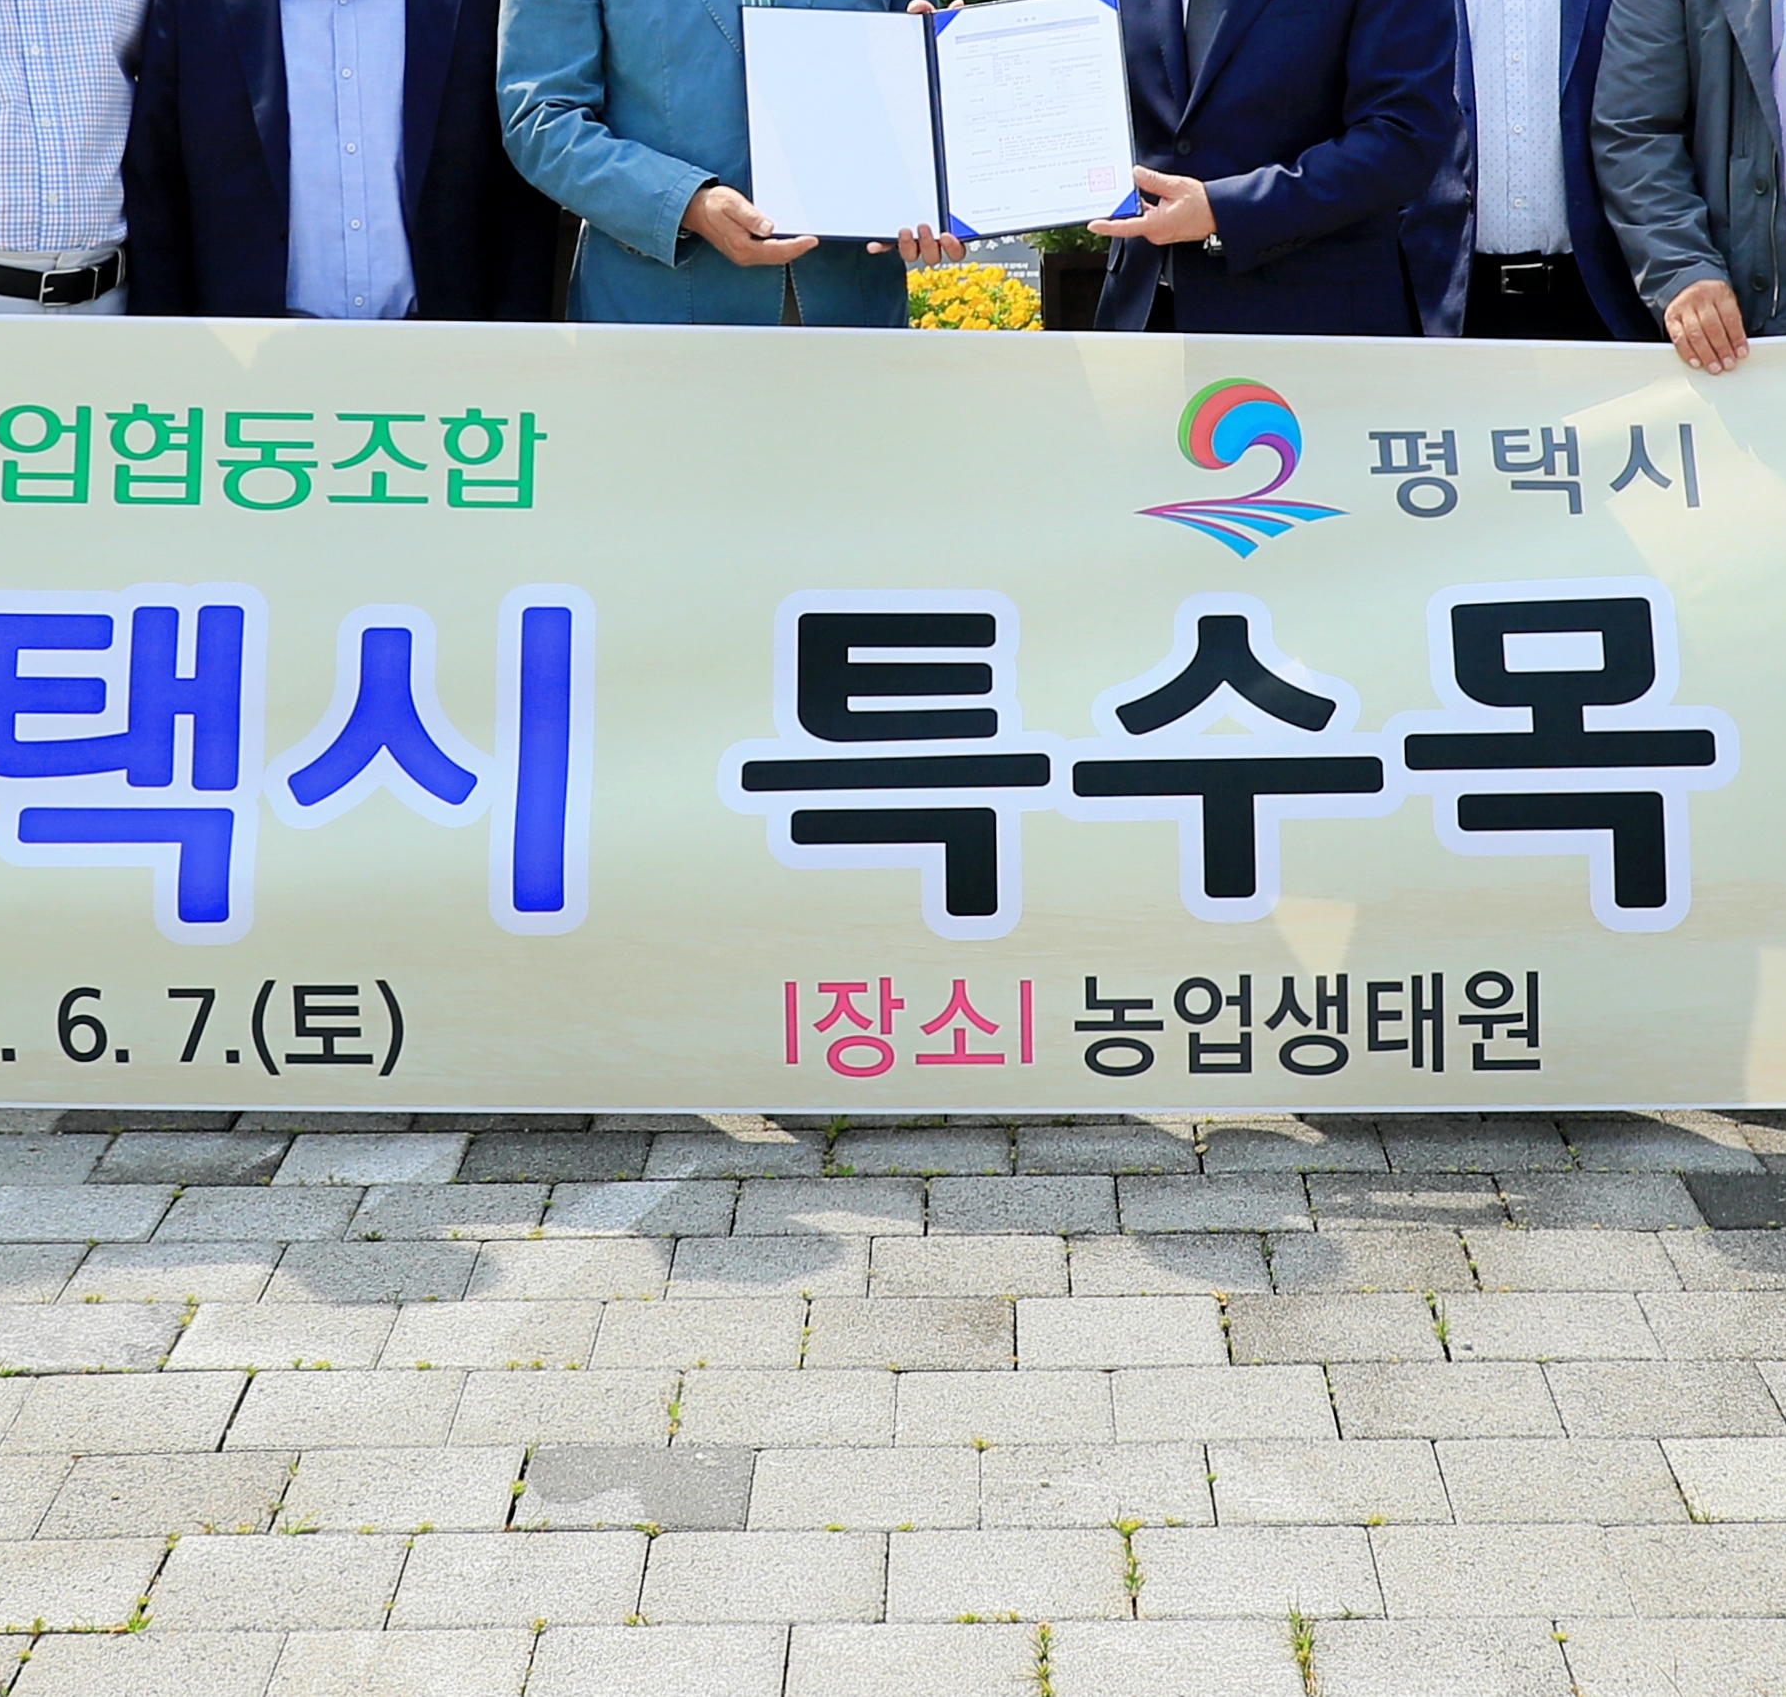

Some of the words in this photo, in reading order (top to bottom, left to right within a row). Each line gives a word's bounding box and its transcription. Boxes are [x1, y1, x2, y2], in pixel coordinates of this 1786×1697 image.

[1367, 420, 1702, 519] 평택시
[740, 596, 1718, 919] 특수목
[56, 985, 132, 1064] 6.
[166, 978, 406, 1078] 7.(토)
[1073, 969, 1543, 1078] 농업생태원
